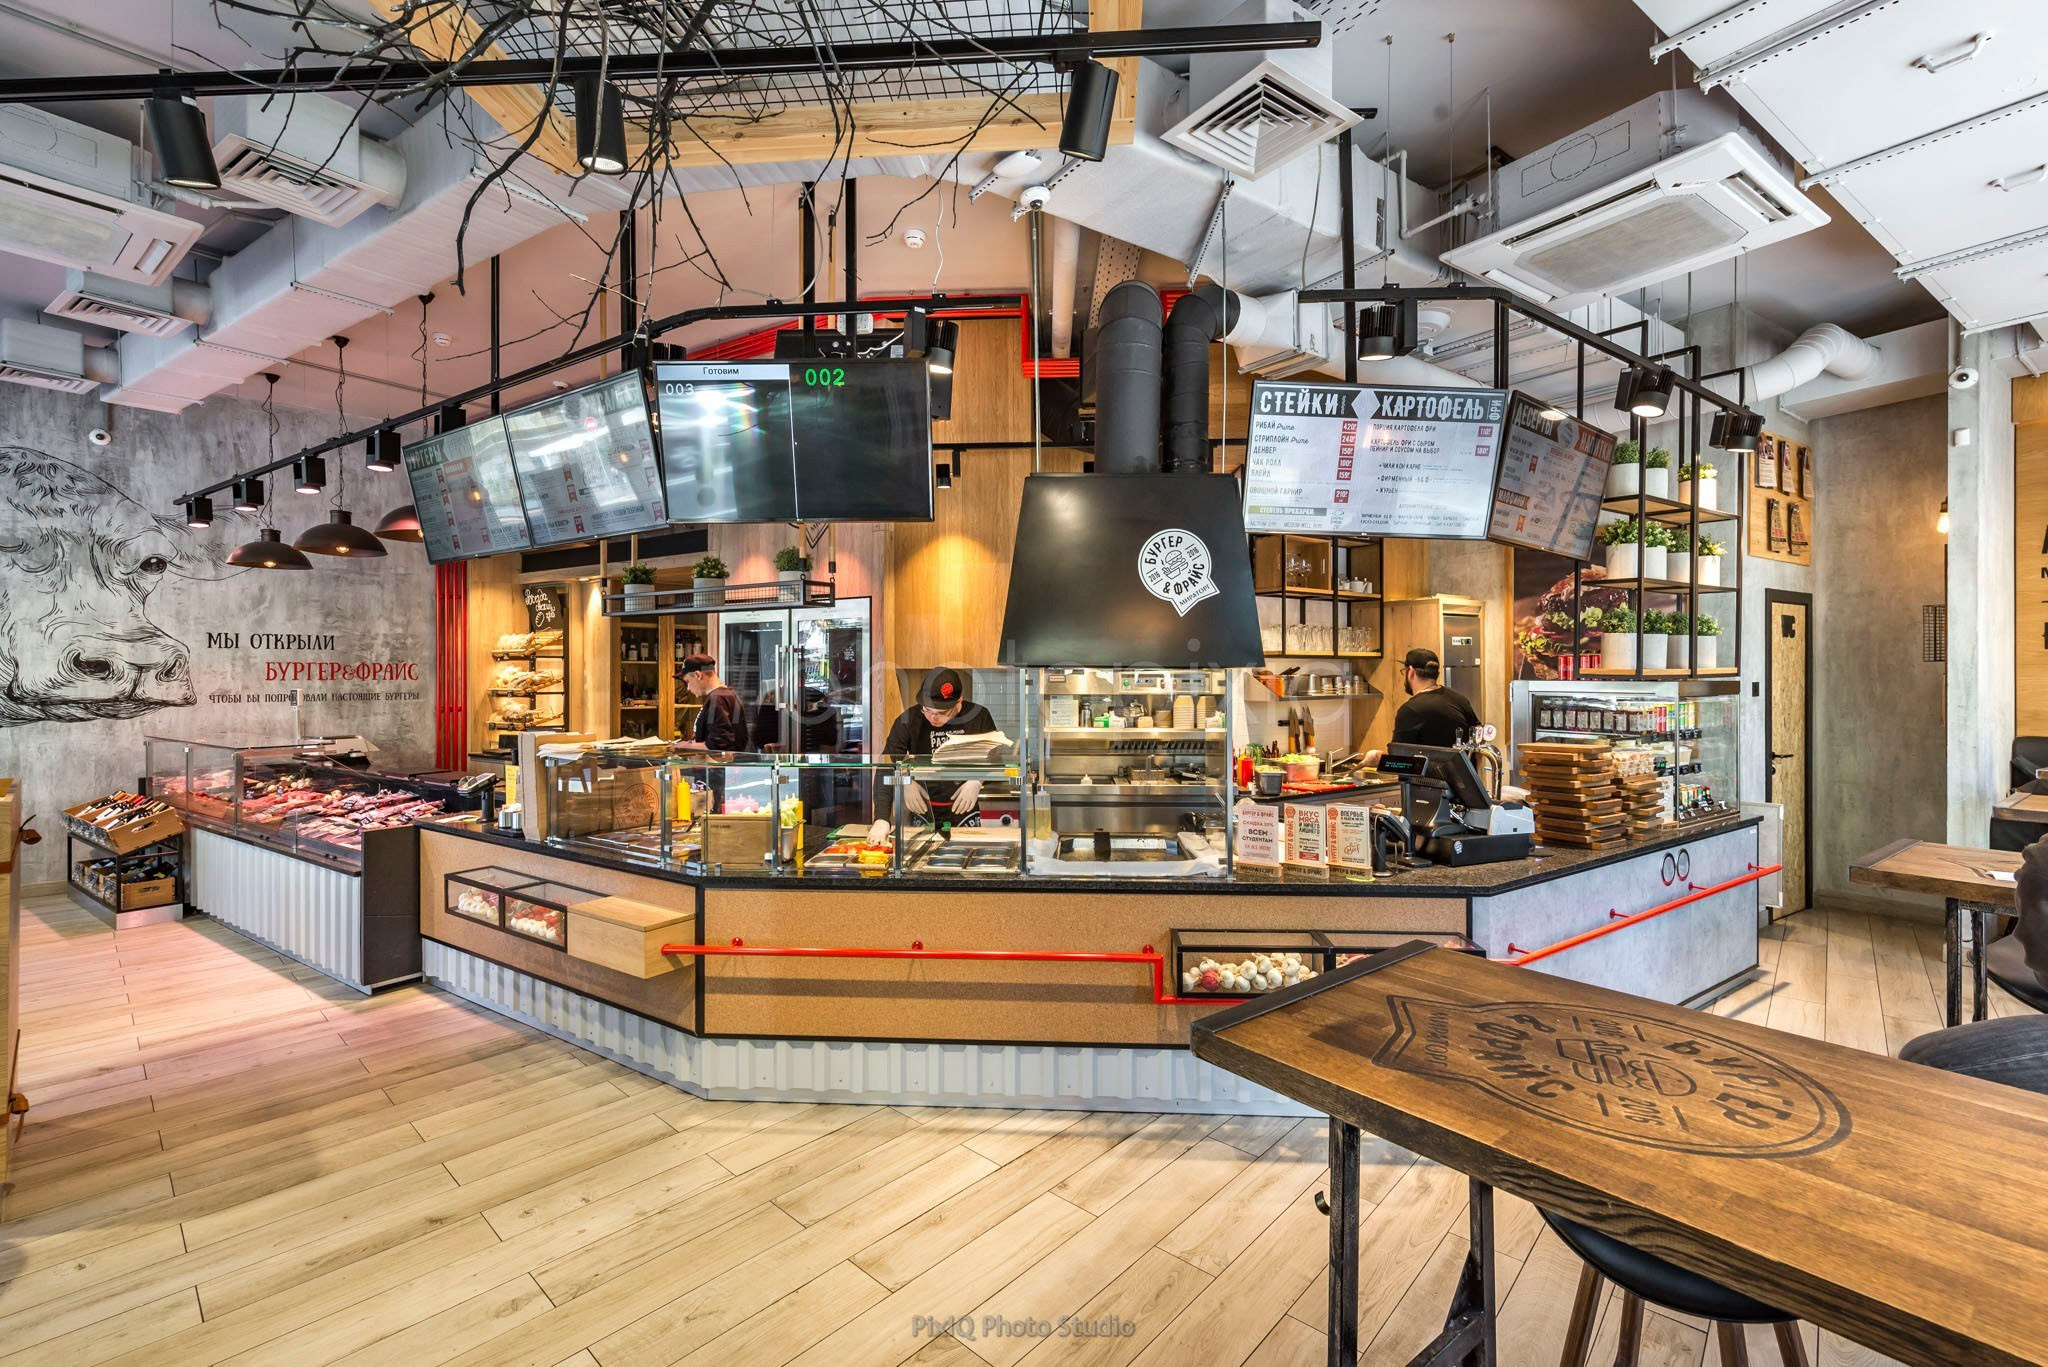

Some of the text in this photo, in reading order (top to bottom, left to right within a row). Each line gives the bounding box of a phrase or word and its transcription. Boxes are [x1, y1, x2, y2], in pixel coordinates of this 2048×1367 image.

[703, 366, 740, 376] Готовим
[805, 368, 845, 387] 002
[665, 383, 695, 396] 003
[1260, 388, 1339, 415] СТЕЙКИ
[1381, 395, 1484, 420] КАРТОФЕЛЬ
[1488, 399, 1502, 420] ФРИ
[1255, 420, 1276, 430] РИБАЙ
[1425, 424, 1436, 432] ФРИ
[1254, 434, 1290, 443] СТРИПЛОЙН
[1253, 446, 1277, 454] ДЕНВЕР
[1145, 536, 1183, 565] БУРГЕР
[1162, 563, 1205, 596] & ФРАЙС
[1179, 584, 1211, 606] МИРАТОРГ
[206, 632, 336, 651] МЫ ОТКРЫЛИ
[208, 693, 242, 704] ЧТОБЫ
[246, 693, 260, 703] ВЫ
[385, 691, 420, 701] БУРГЕРЫ
[1248, 828, 1268, 836] ВСЕМ
[1424, 1010, 1450, 1068] МИРАТОРГ
[1662, 1039, 1795, 1130] БУРГЕР
